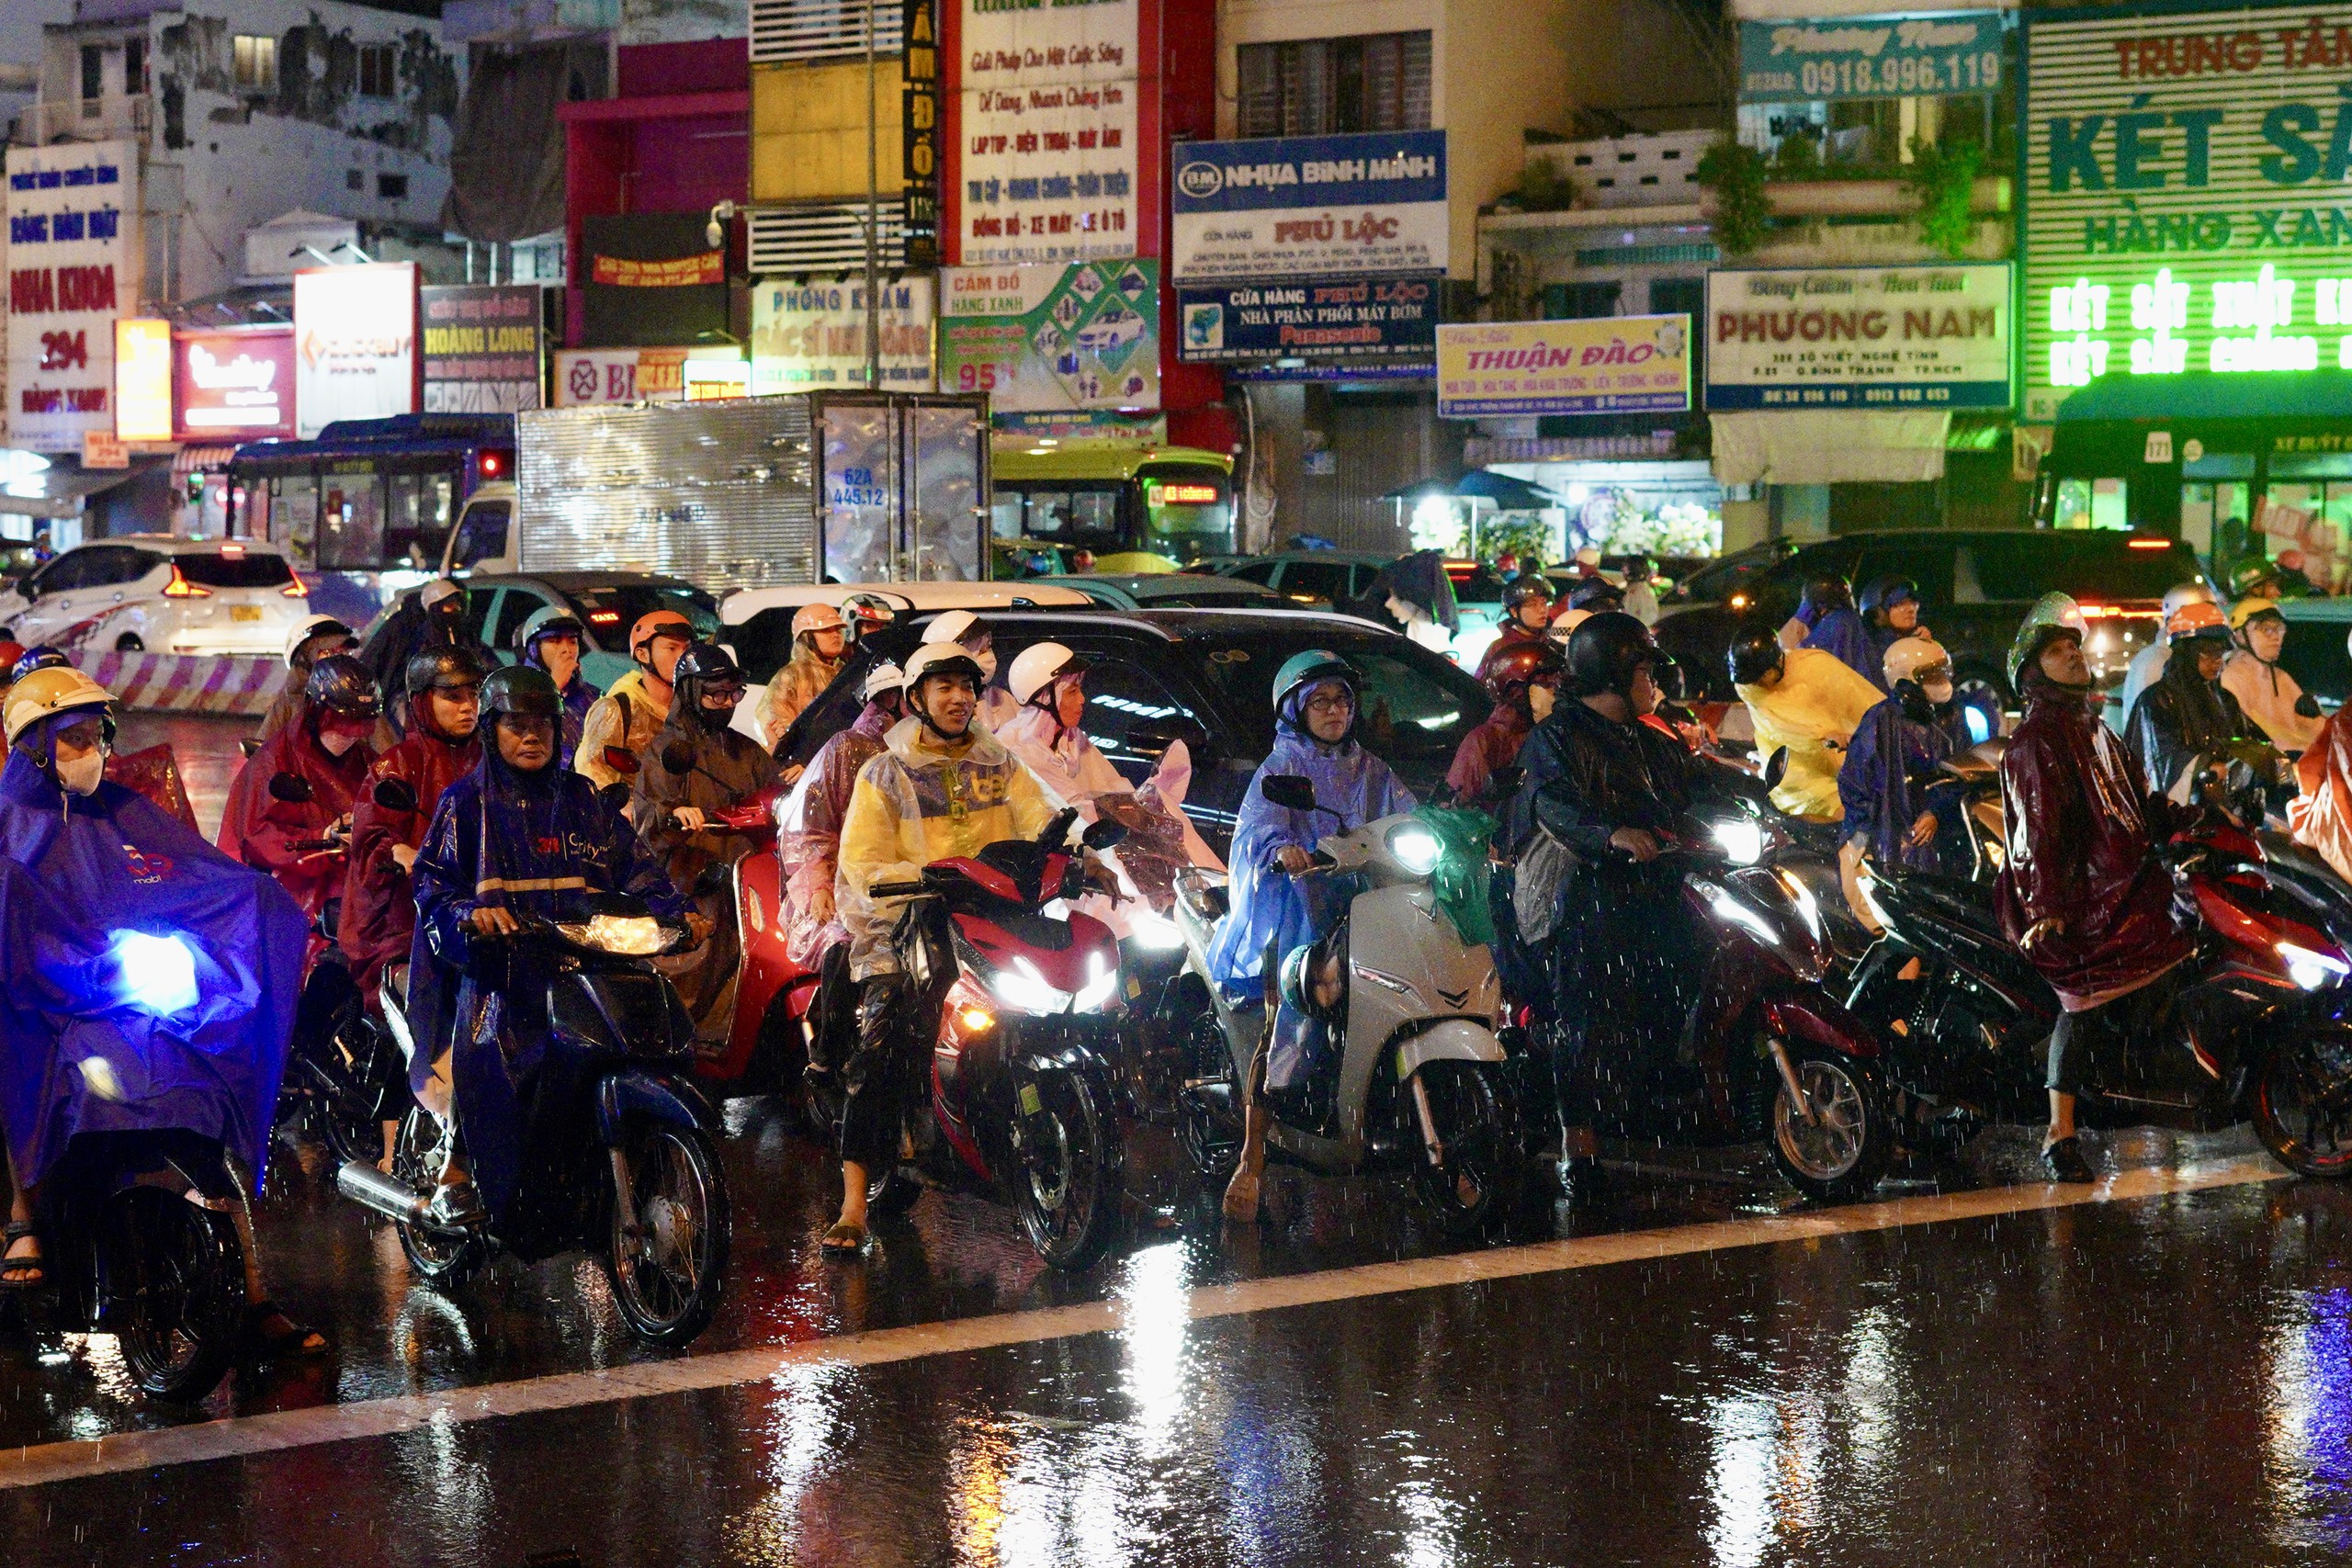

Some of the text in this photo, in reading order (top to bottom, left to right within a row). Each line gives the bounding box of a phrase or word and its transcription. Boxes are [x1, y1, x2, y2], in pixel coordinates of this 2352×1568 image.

[1801, 52, 2000, 95] 0918.996.119
[2114, 33, 2263, 78] TRUNG
[2048, 92, 2224, 193] KÉT
[1225, 163, 1298, 192] NHỰA
[2084, 194, 2233, 254] HÀNG
[10, 264, 117, 313] NHA KHOA
[1229, 285, 1261, 307] CỬA
[1264, 286, 1306, 305] HÀNG
[1375, 279, 1429, 304] LỘC
[2051, 276, 2109, 332] KÉT
[1239, 303, 1422, 326] NHÀ PHÂN PHỐI MÁY BƠM
[1280, 321, 1382, 344] Panasonic
[1717, 306, 1996, 343] PHƯƠNG NAM
[424, 323, 484, 355] HOÀNG
[488, 326, 535, 352] LONG
[1467, 337, 1654, 373] THUẬN ĐÀO
[2051, 333, 2109, 386] KÉT
[844, 469, 872, 485] 62A
[834, 489, 884, 505] 445.12
[591, 613, 618, 622] TAXI
